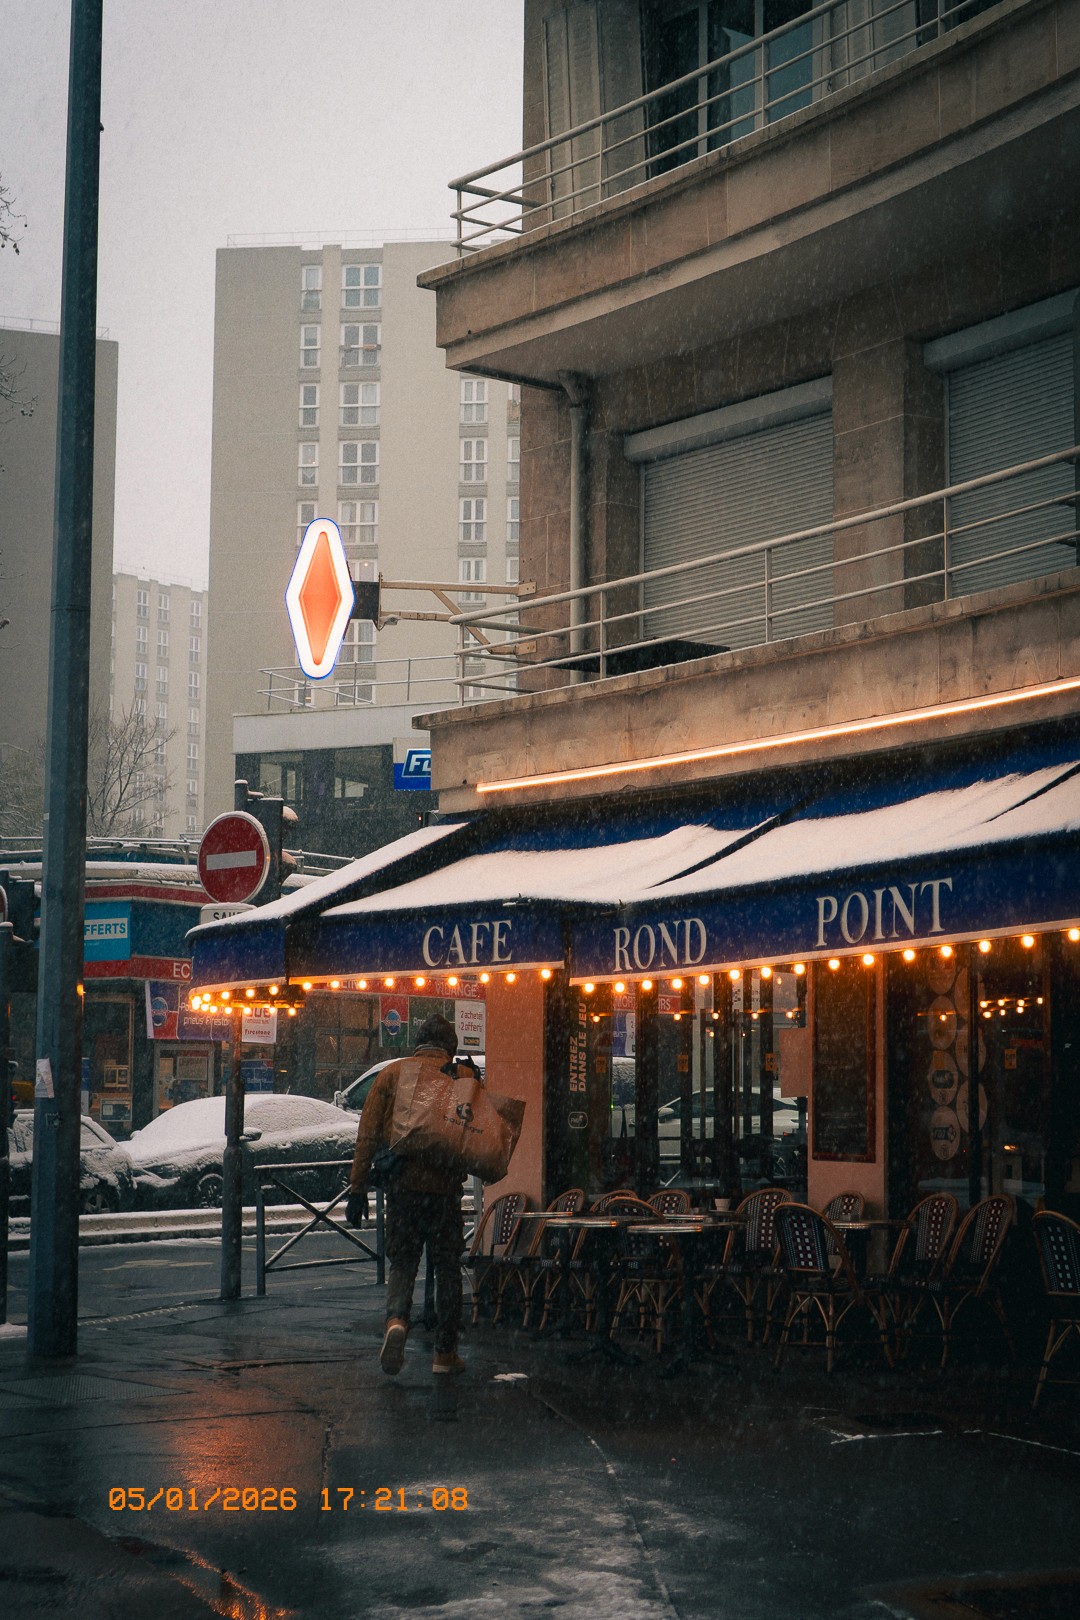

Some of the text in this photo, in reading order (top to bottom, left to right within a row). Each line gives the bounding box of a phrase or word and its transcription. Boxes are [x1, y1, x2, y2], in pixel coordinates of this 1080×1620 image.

[84, 922, 126, 936] FFERTS
[422, 920, 512, 967] CAFE
[613, 877, 953, 972] ROND POINT
[569, 1036, 578, 1092] ENTREZ
[578, 1002, 587, 1092] DANS LE JEU
